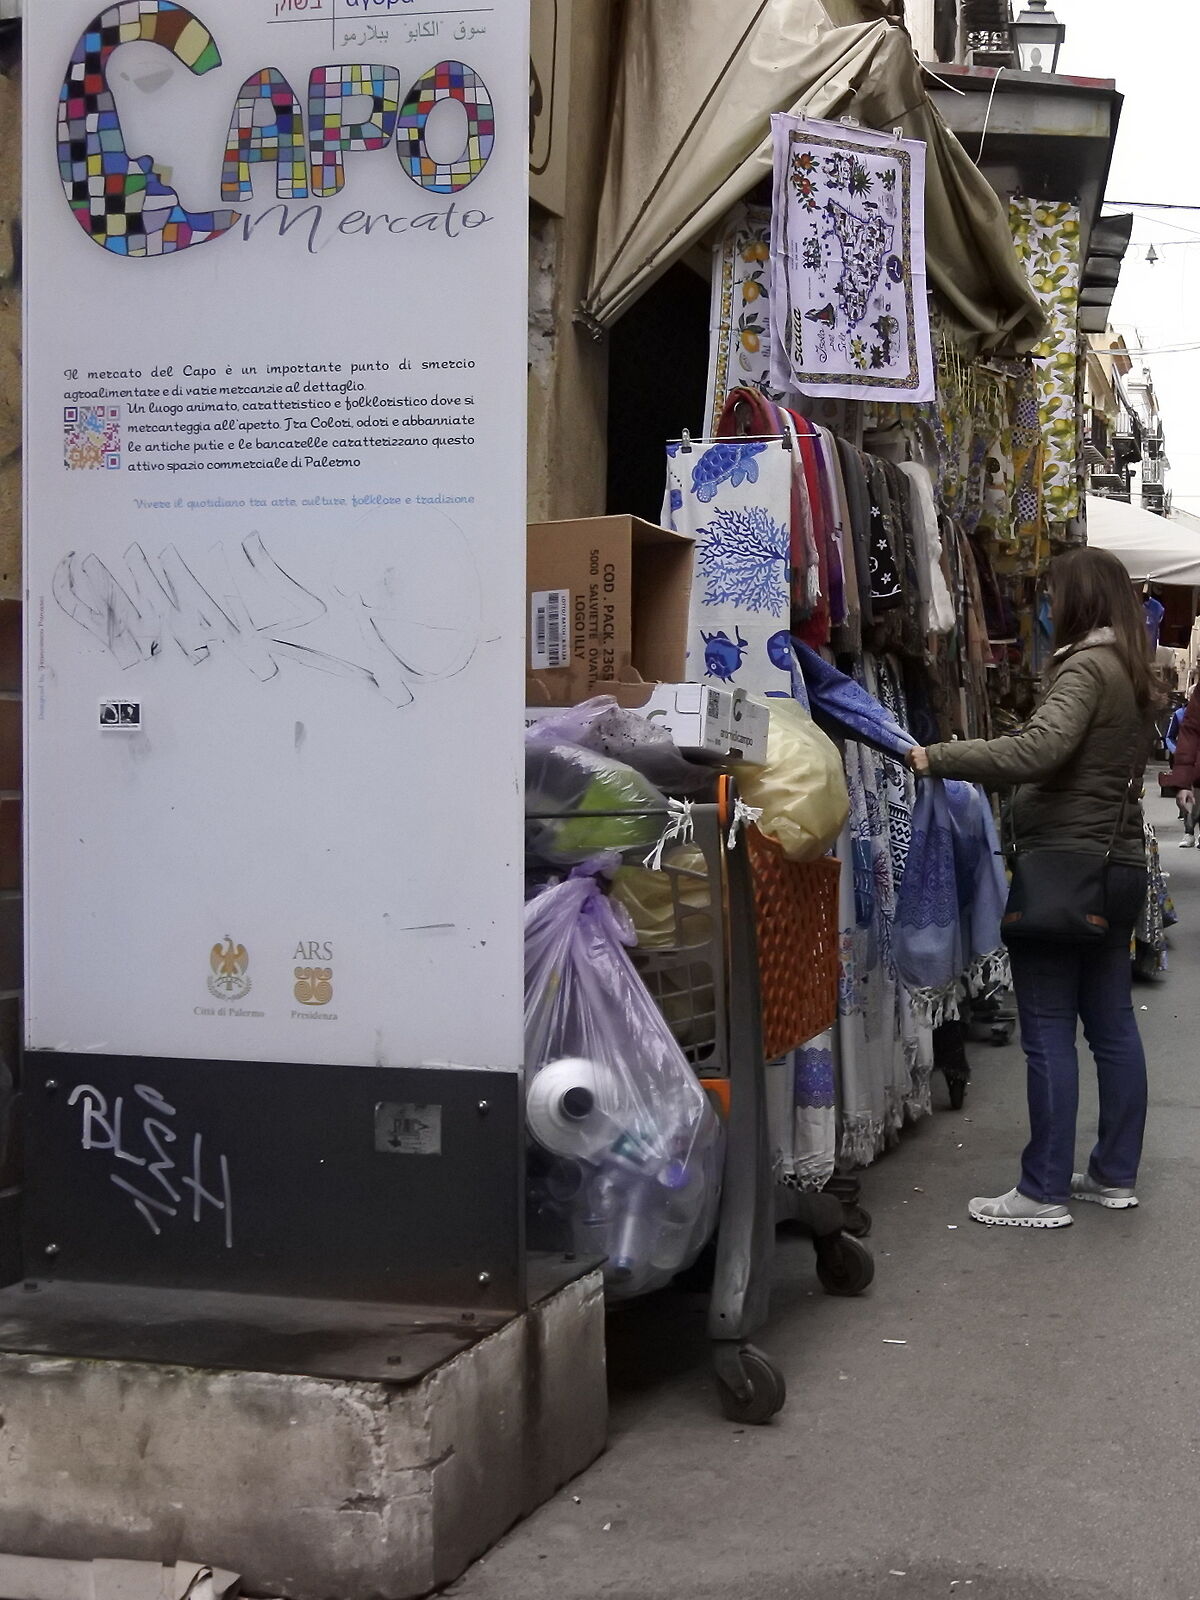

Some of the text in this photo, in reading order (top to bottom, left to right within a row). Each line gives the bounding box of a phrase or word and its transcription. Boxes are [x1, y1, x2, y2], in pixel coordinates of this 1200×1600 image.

[453, 20, 486, 41] سوق
[57, 0, 495, 257] CAPO
[242, 202, 494, 254] Mercato
[64, 358, 476, 380] Il mercato del Capo è un importante punto di smercio
[63, 388, 160, 402] agroalimentare
[171, 385, 183, 396] di
[186, 386, 217, 396] varie
[219, 382, 283, 395] mercanzie
[285, 382, 300, 393] al
[303, 379, 366, 395] dettaglio.
[127, 402, 145, 414] Un
[149, 401, 184, 416] luogo
[242, 397, 332, 411] caratteristico
[334, 401, 342, 409] e
[346, 395, 428, 410] folkloristico
[430, 394, 461, 406] dove
[464, 395, 475, 405] si
[127, 421, 211, 435] mercanteggia
[284, 417, 307, 431] Tra
[356, 415, 389, 427] odori
[392, 418, 399, 427] e
[402, 414, 475, 426] abbanniate
[127, 435, 475, 454] le antiche putie e le bancarelle caratterizzano questo
[127, 456, 361, 474] attivo spazio commerciale di Palermo
[589, 549, 599, 576] 5000
[603, 563, 615, 593] COD
[588, 584, 599, 640] SALVIETTE
[574, 594, 586, 661] LOGO ILLY
[603, 604, 615, 645] PACK.
[292, 940, 334, 961] ARS
